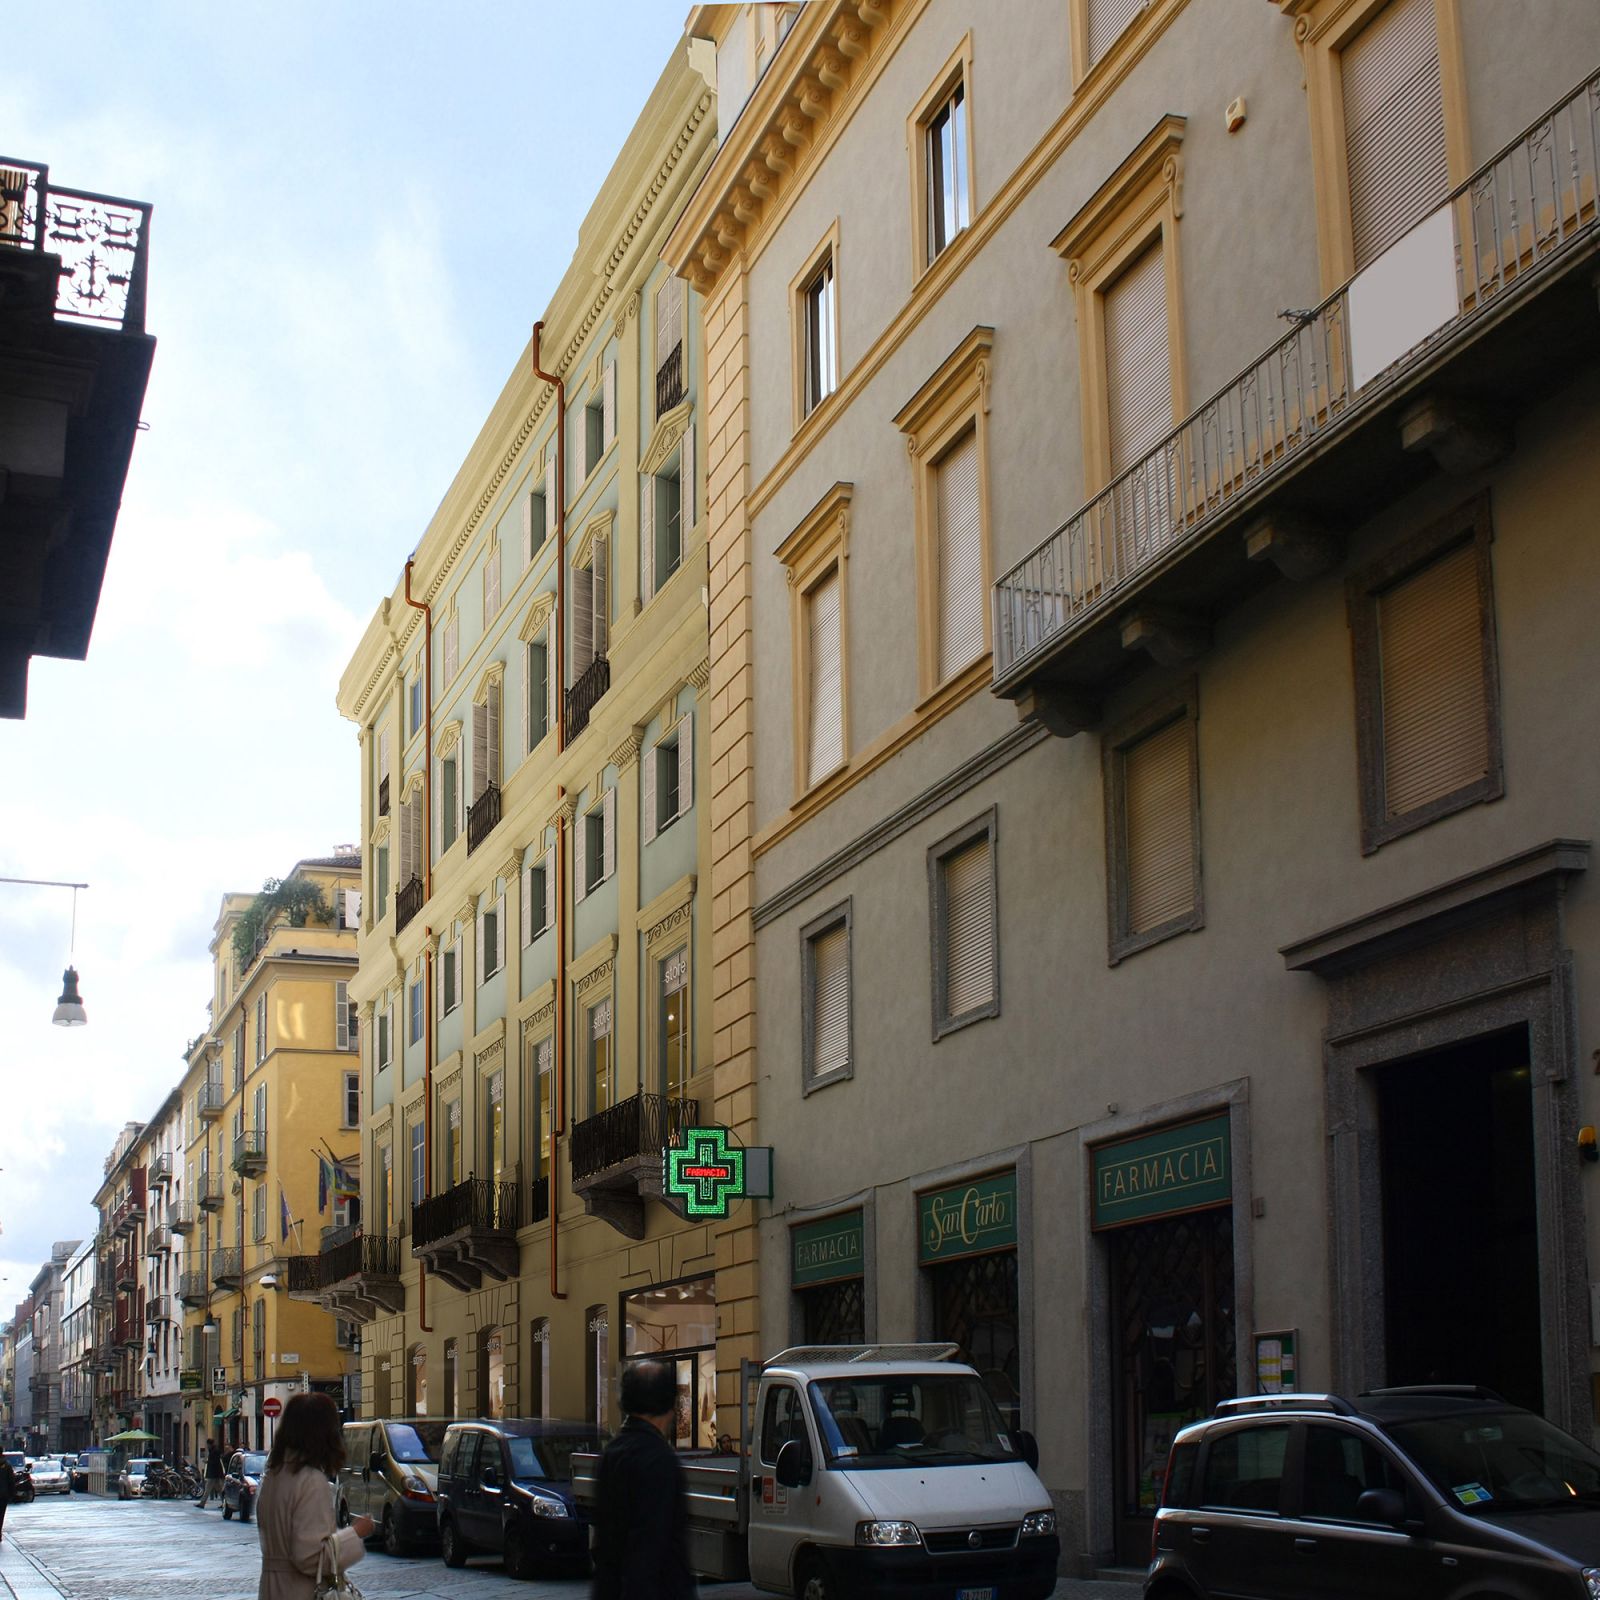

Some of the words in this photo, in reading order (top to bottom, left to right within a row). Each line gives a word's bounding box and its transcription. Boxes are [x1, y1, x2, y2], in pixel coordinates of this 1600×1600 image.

[665, 961, 686, 984] store
[594, 1009, 611, 1029] store
[686, 1167, 726, 1177] FARMACIA
[1104, 1147, 1217, 1198] FARMACIA
[928, 1197, 959, 1251] San
[798, 1233, 859, 1265] FARMACIA
